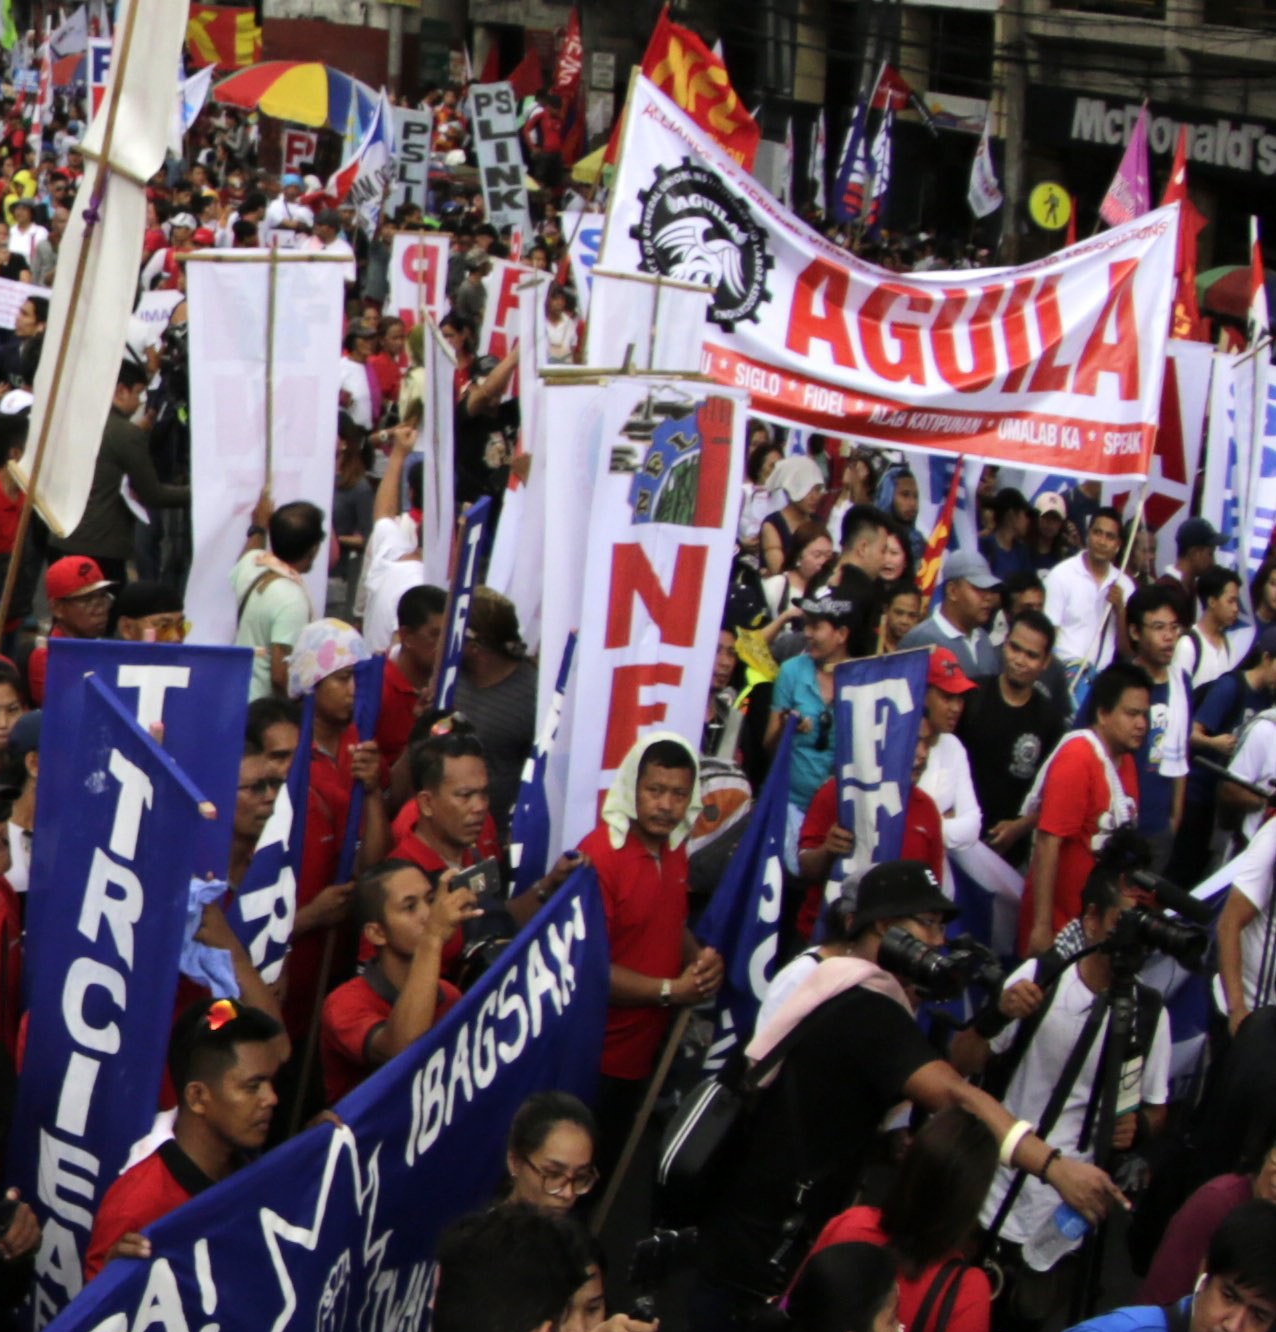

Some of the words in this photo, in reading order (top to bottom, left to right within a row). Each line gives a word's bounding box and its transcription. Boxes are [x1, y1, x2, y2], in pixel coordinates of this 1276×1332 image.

[1071, 96, 1276, 176] McDoald's
[786, 256, 1140, 403] AGUILA
[735, 363, 780, 396] SIGLO
[803, 383, 846, 417] FIDEL
[868, 404, 906, 425] ALAB
[907, 410, 982, 435] KATIPUNAN
[997, 417, 1057, 446] UMALAB
[1060, 425, 1081, 450] KA
[1102, 429, 1143, 456] SPEAK
